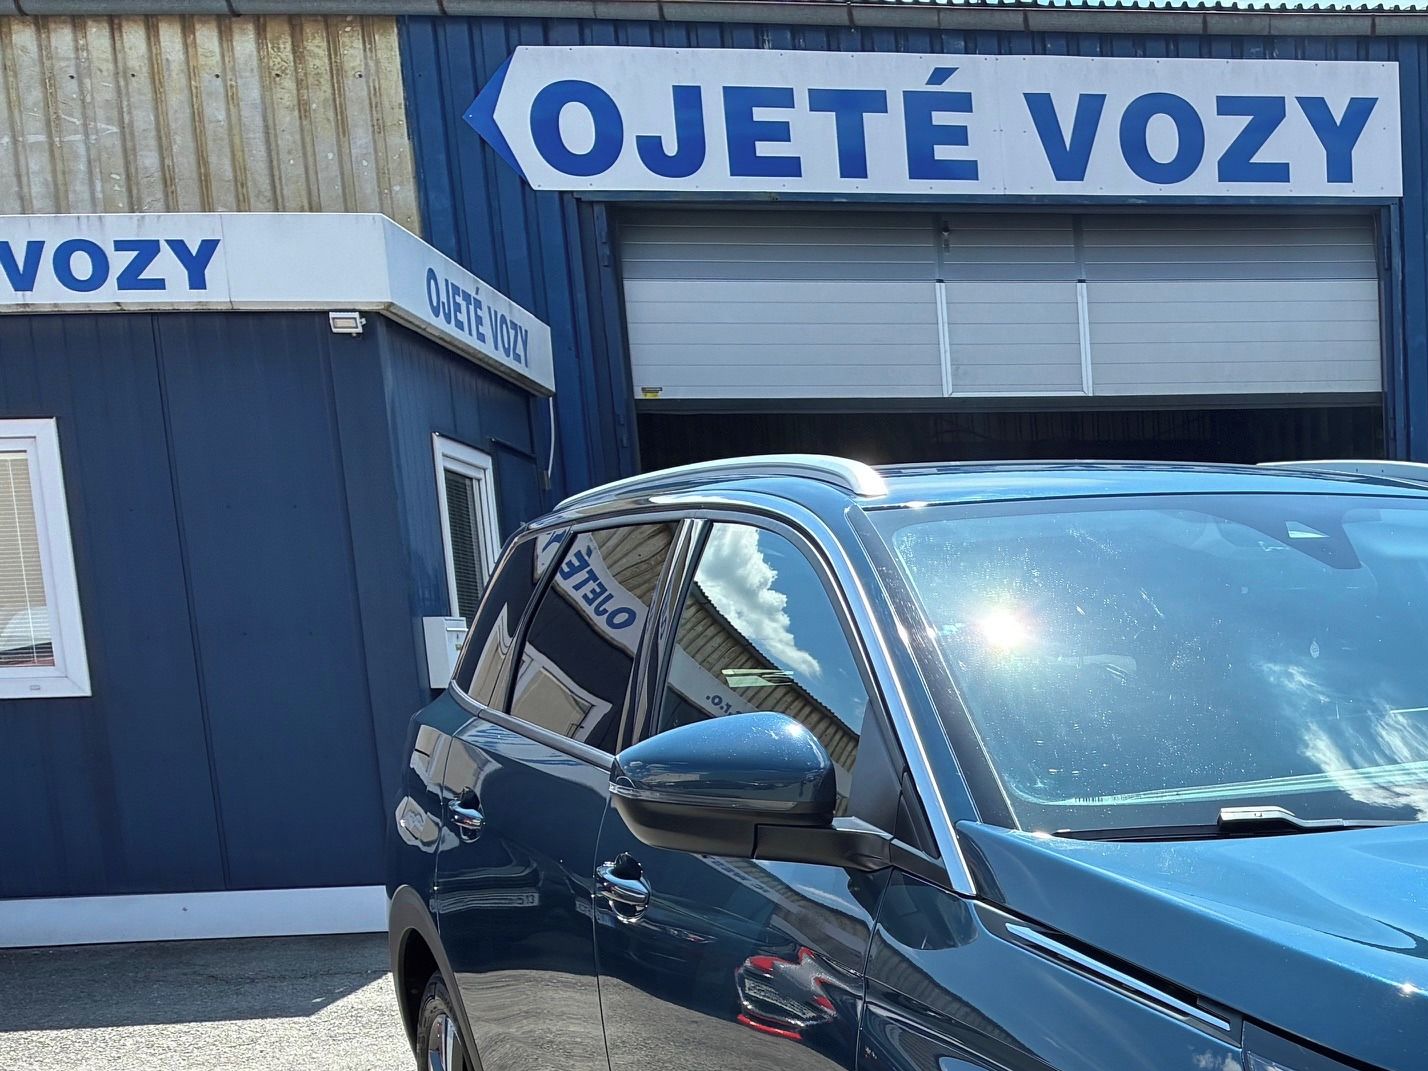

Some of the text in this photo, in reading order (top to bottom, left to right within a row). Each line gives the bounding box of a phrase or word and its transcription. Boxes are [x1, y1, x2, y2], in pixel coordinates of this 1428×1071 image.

[530, 67, 1379, 184] OJETÉ VOZY
[0, 238, 221, 292] VOZY
[426, 267, 528, 368] OJETÉ VOZY
